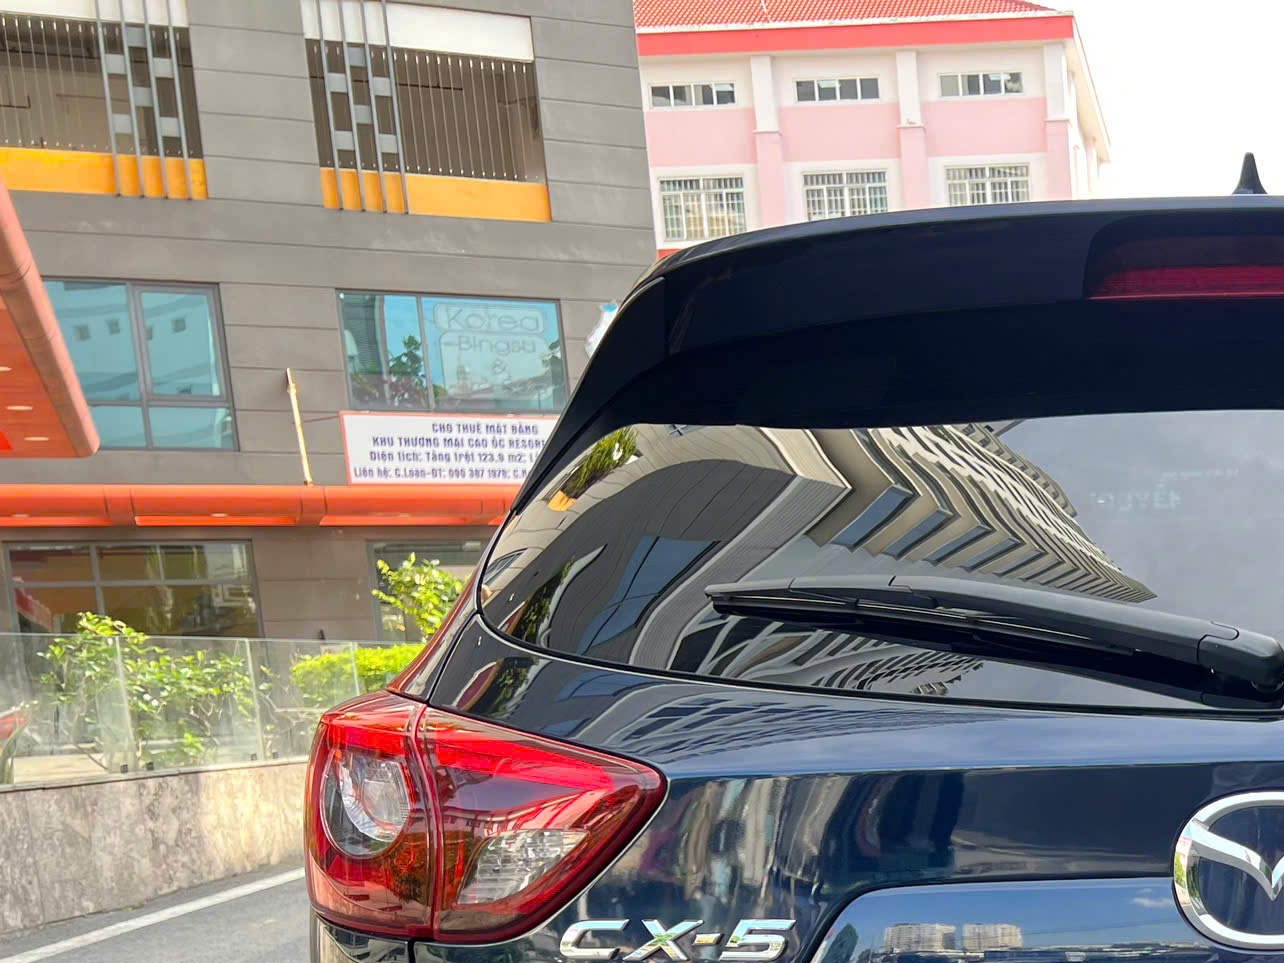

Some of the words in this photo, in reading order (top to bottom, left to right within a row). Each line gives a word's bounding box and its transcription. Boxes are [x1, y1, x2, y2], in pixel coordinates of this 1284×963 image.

[447, 308, 540, 331] Korea
[432, 423, 453, 433] CHO
[372, 436, 394, 447] KHU
[468, 438, 488, 448] CAO
[559, 918, 797, 961] CX-5
